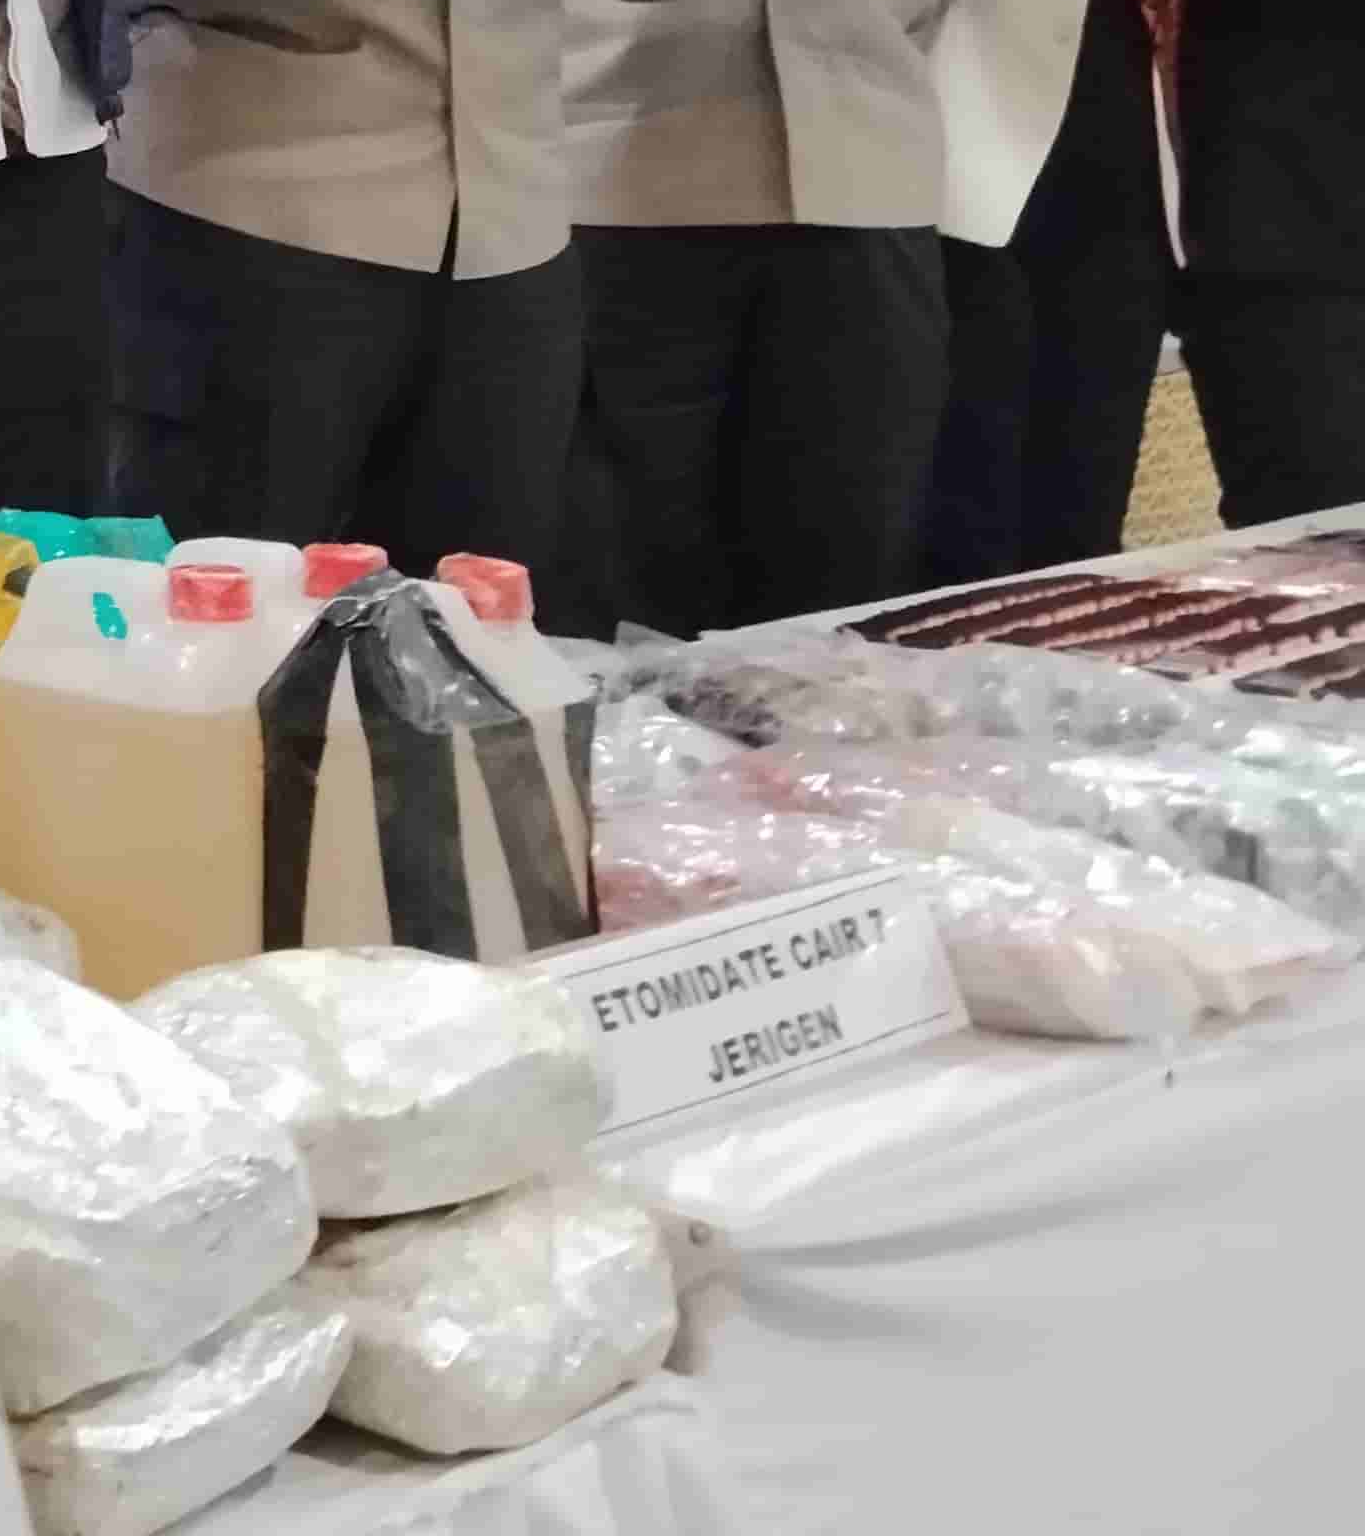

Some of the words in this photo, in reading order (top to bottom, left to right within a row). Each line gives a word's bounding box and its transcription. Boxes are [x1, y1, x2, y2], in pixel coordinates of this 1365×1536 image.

[591, 943, 786, 1032] ETOMIDATE
[789, 916, 868, 971] CAIR
[708, 1003, 844, 1084] JERIGEN
